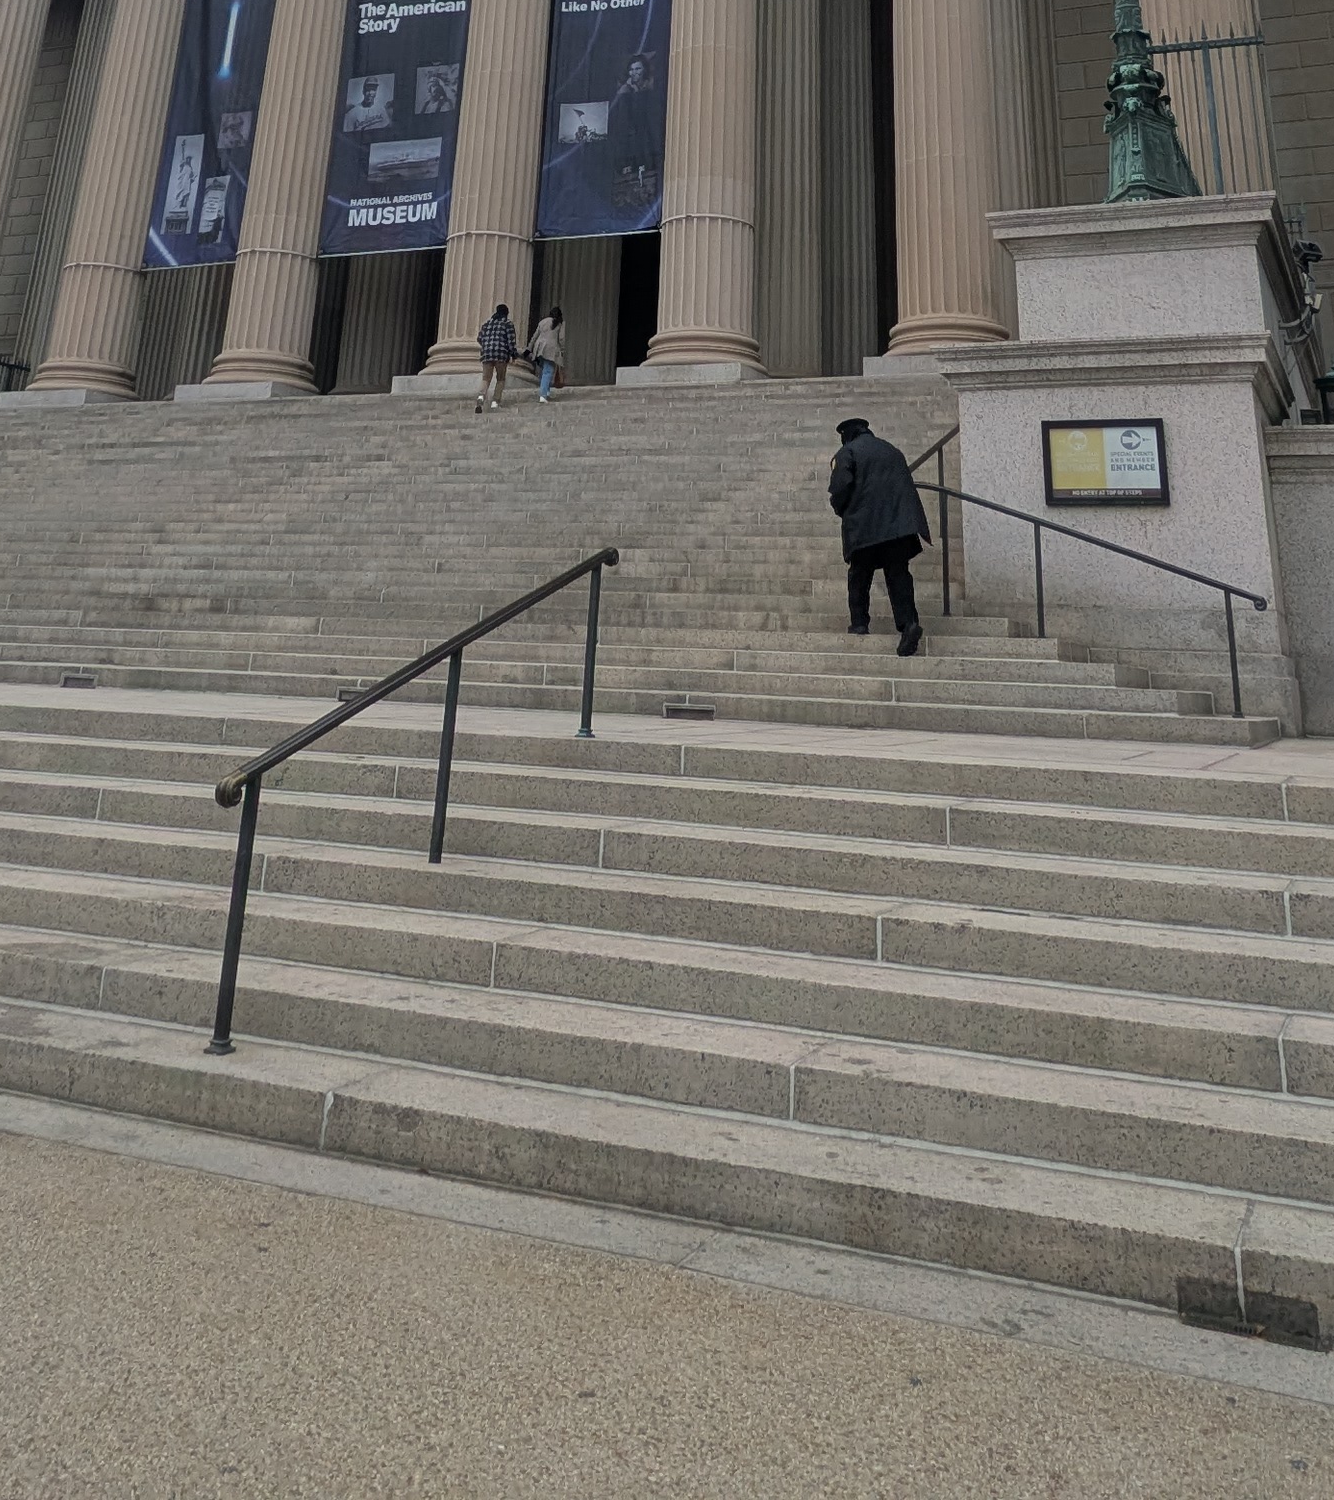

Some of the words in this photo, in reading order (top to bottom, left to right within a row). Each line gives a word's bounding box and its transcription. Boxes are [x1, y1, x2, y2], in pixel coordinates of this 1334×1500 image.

[358, 2, 386, 19] The
[561, 1, 588, 13] Like
[590, 0, 608, 12] No
[357, 18, 401, 35] Story
[349, 196, 392, 207] NATIONAL
[392, 192, 433, 204] ARCHIVES
[347, 201, 438, 227] MUSEUM
[1110, 463, 1156, 472] ENTRANCE
